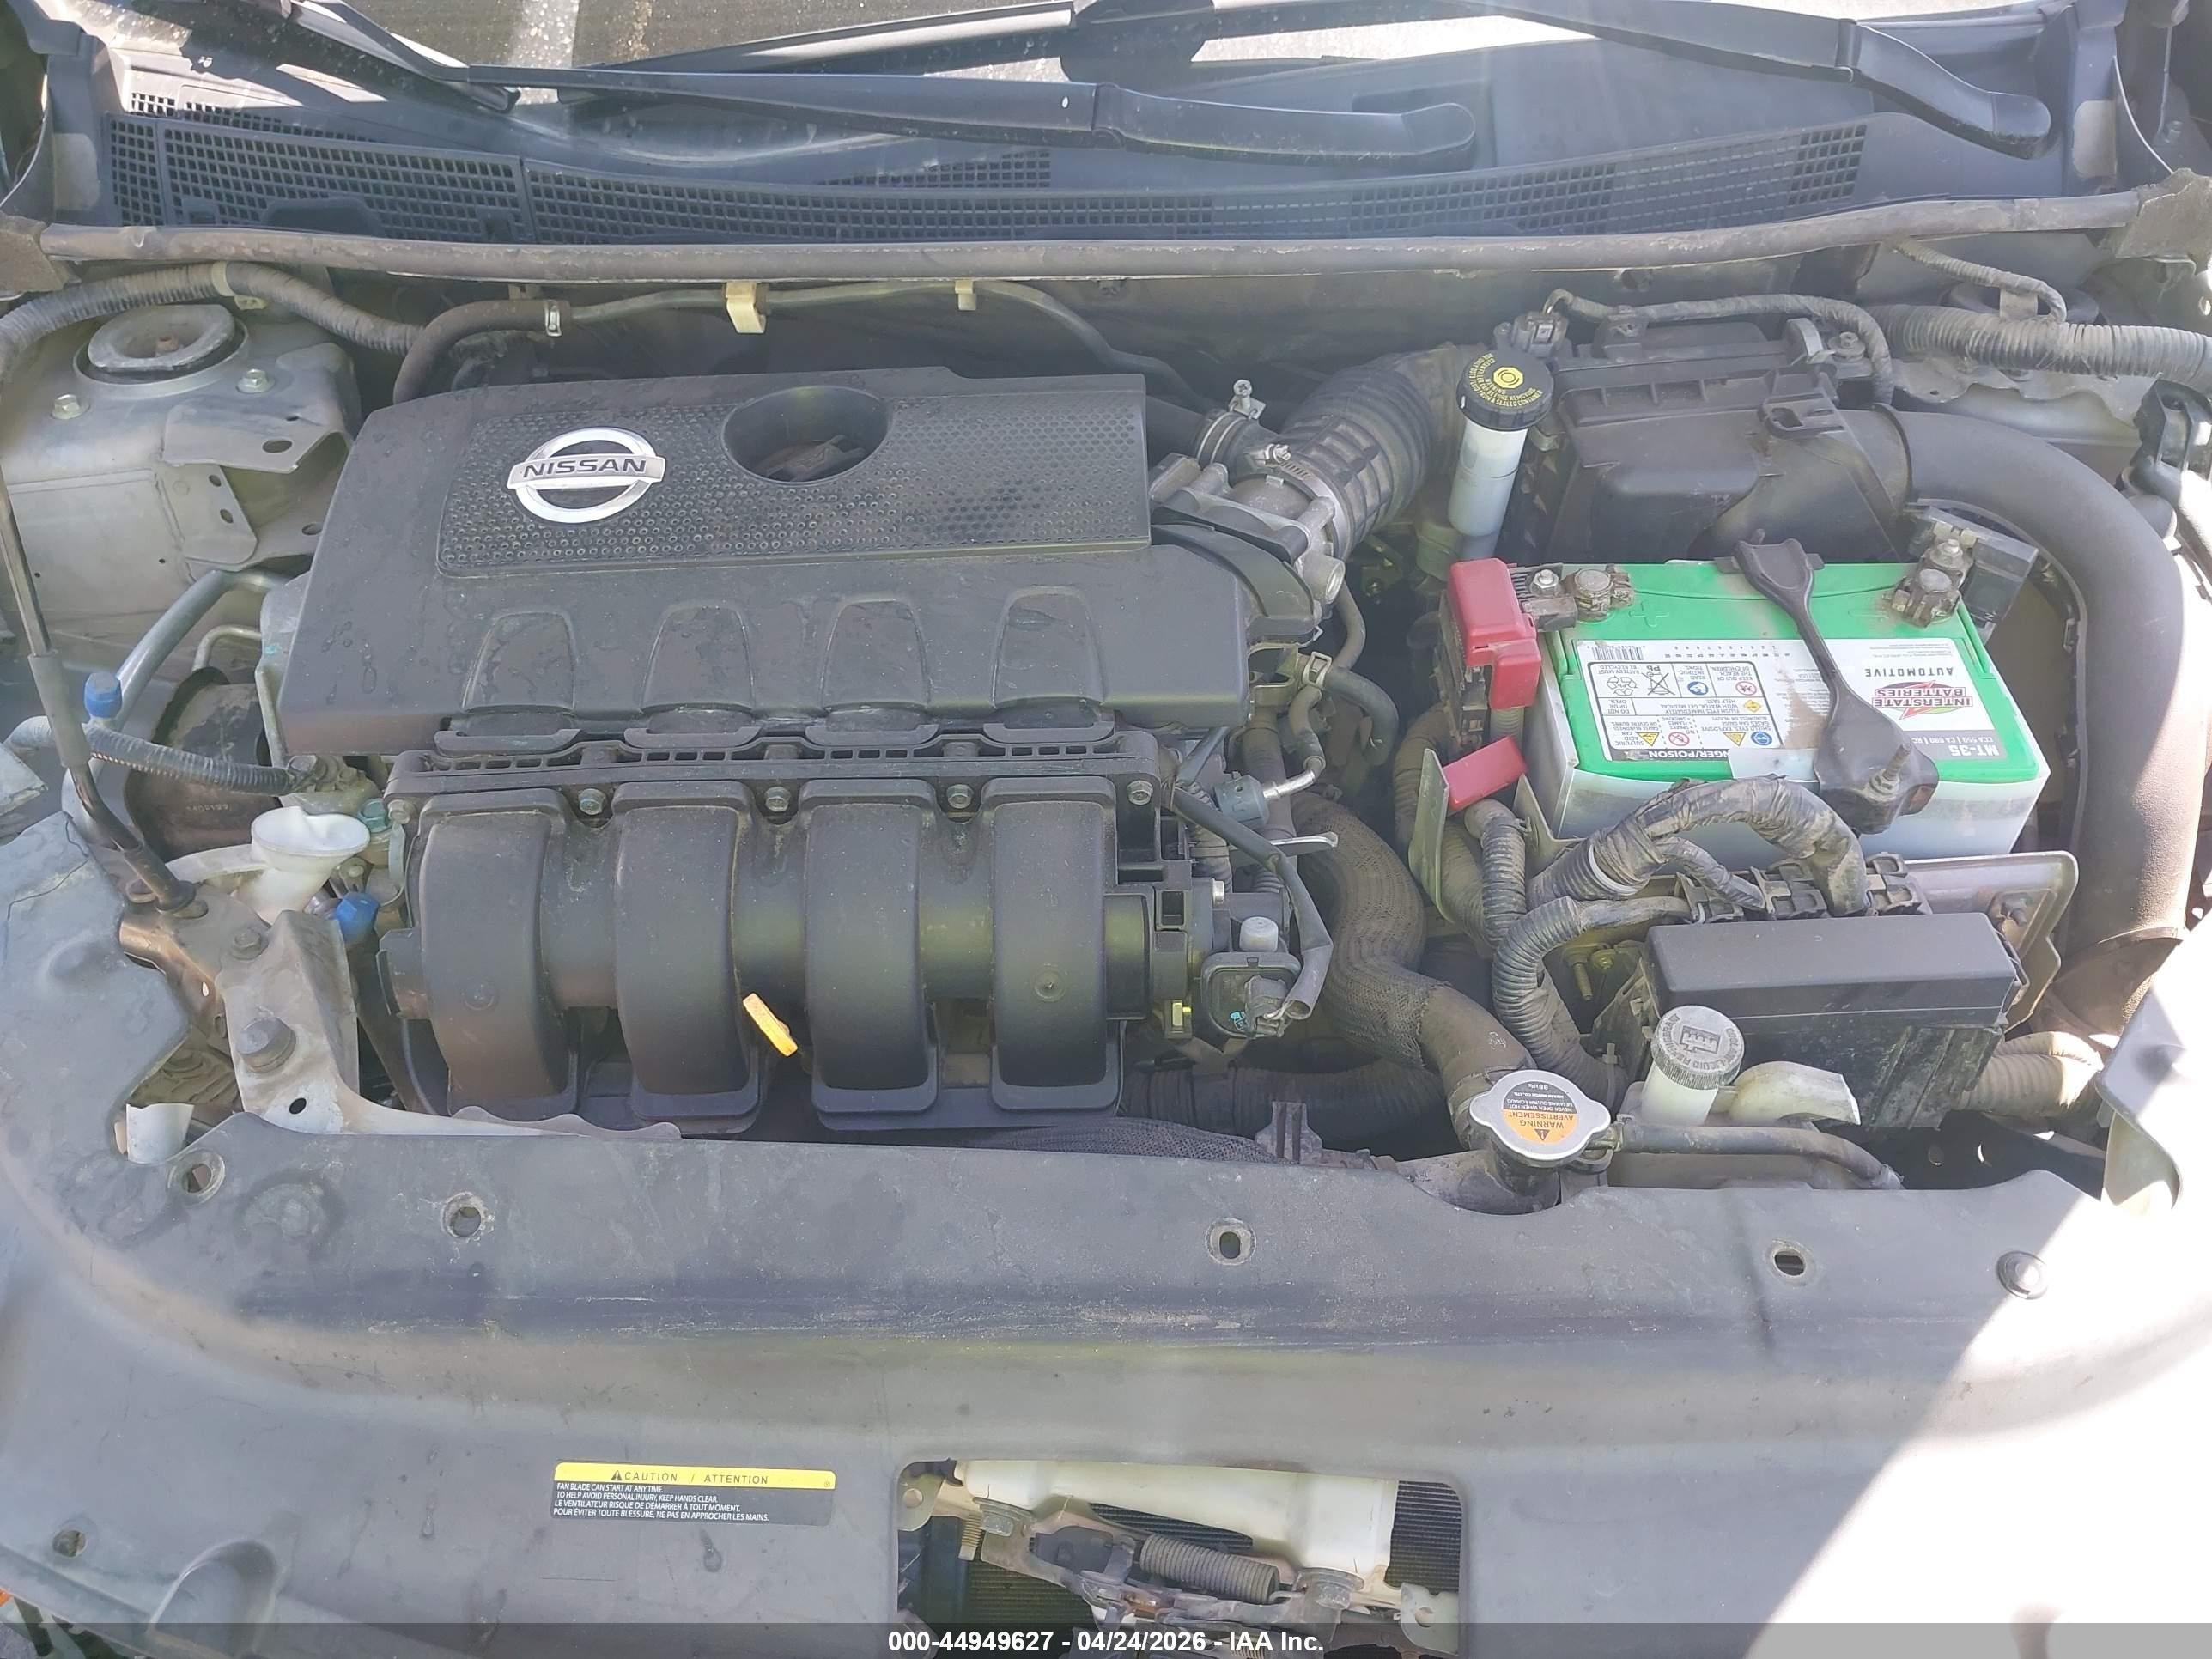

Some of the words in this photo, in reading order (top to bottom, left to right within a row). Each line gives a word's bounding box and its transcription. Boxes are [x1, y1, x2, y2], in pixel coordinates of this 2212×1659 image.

[523, 459, 646, 477] NISSAN
[1865, 667, 1954, 677] AUTOMOTIVE
[1877, 689, 1963, 697] BATTERIES
[1875, 698, 1970, 707] INTERSTATE
[1948, 744, 2000, 757] MT-35
[624, 1471, 678, 1481] CAUTION
[704, 1475, 768, 1484] ATTENTION
[644, 1502, 682, 1510] DÉMARRER
[574, 1508, 596, 1516] ÉVITER
[620, 1510, 655, 1518] BLESSURE,
[745, 1513, 769, 1522] MAINS.
